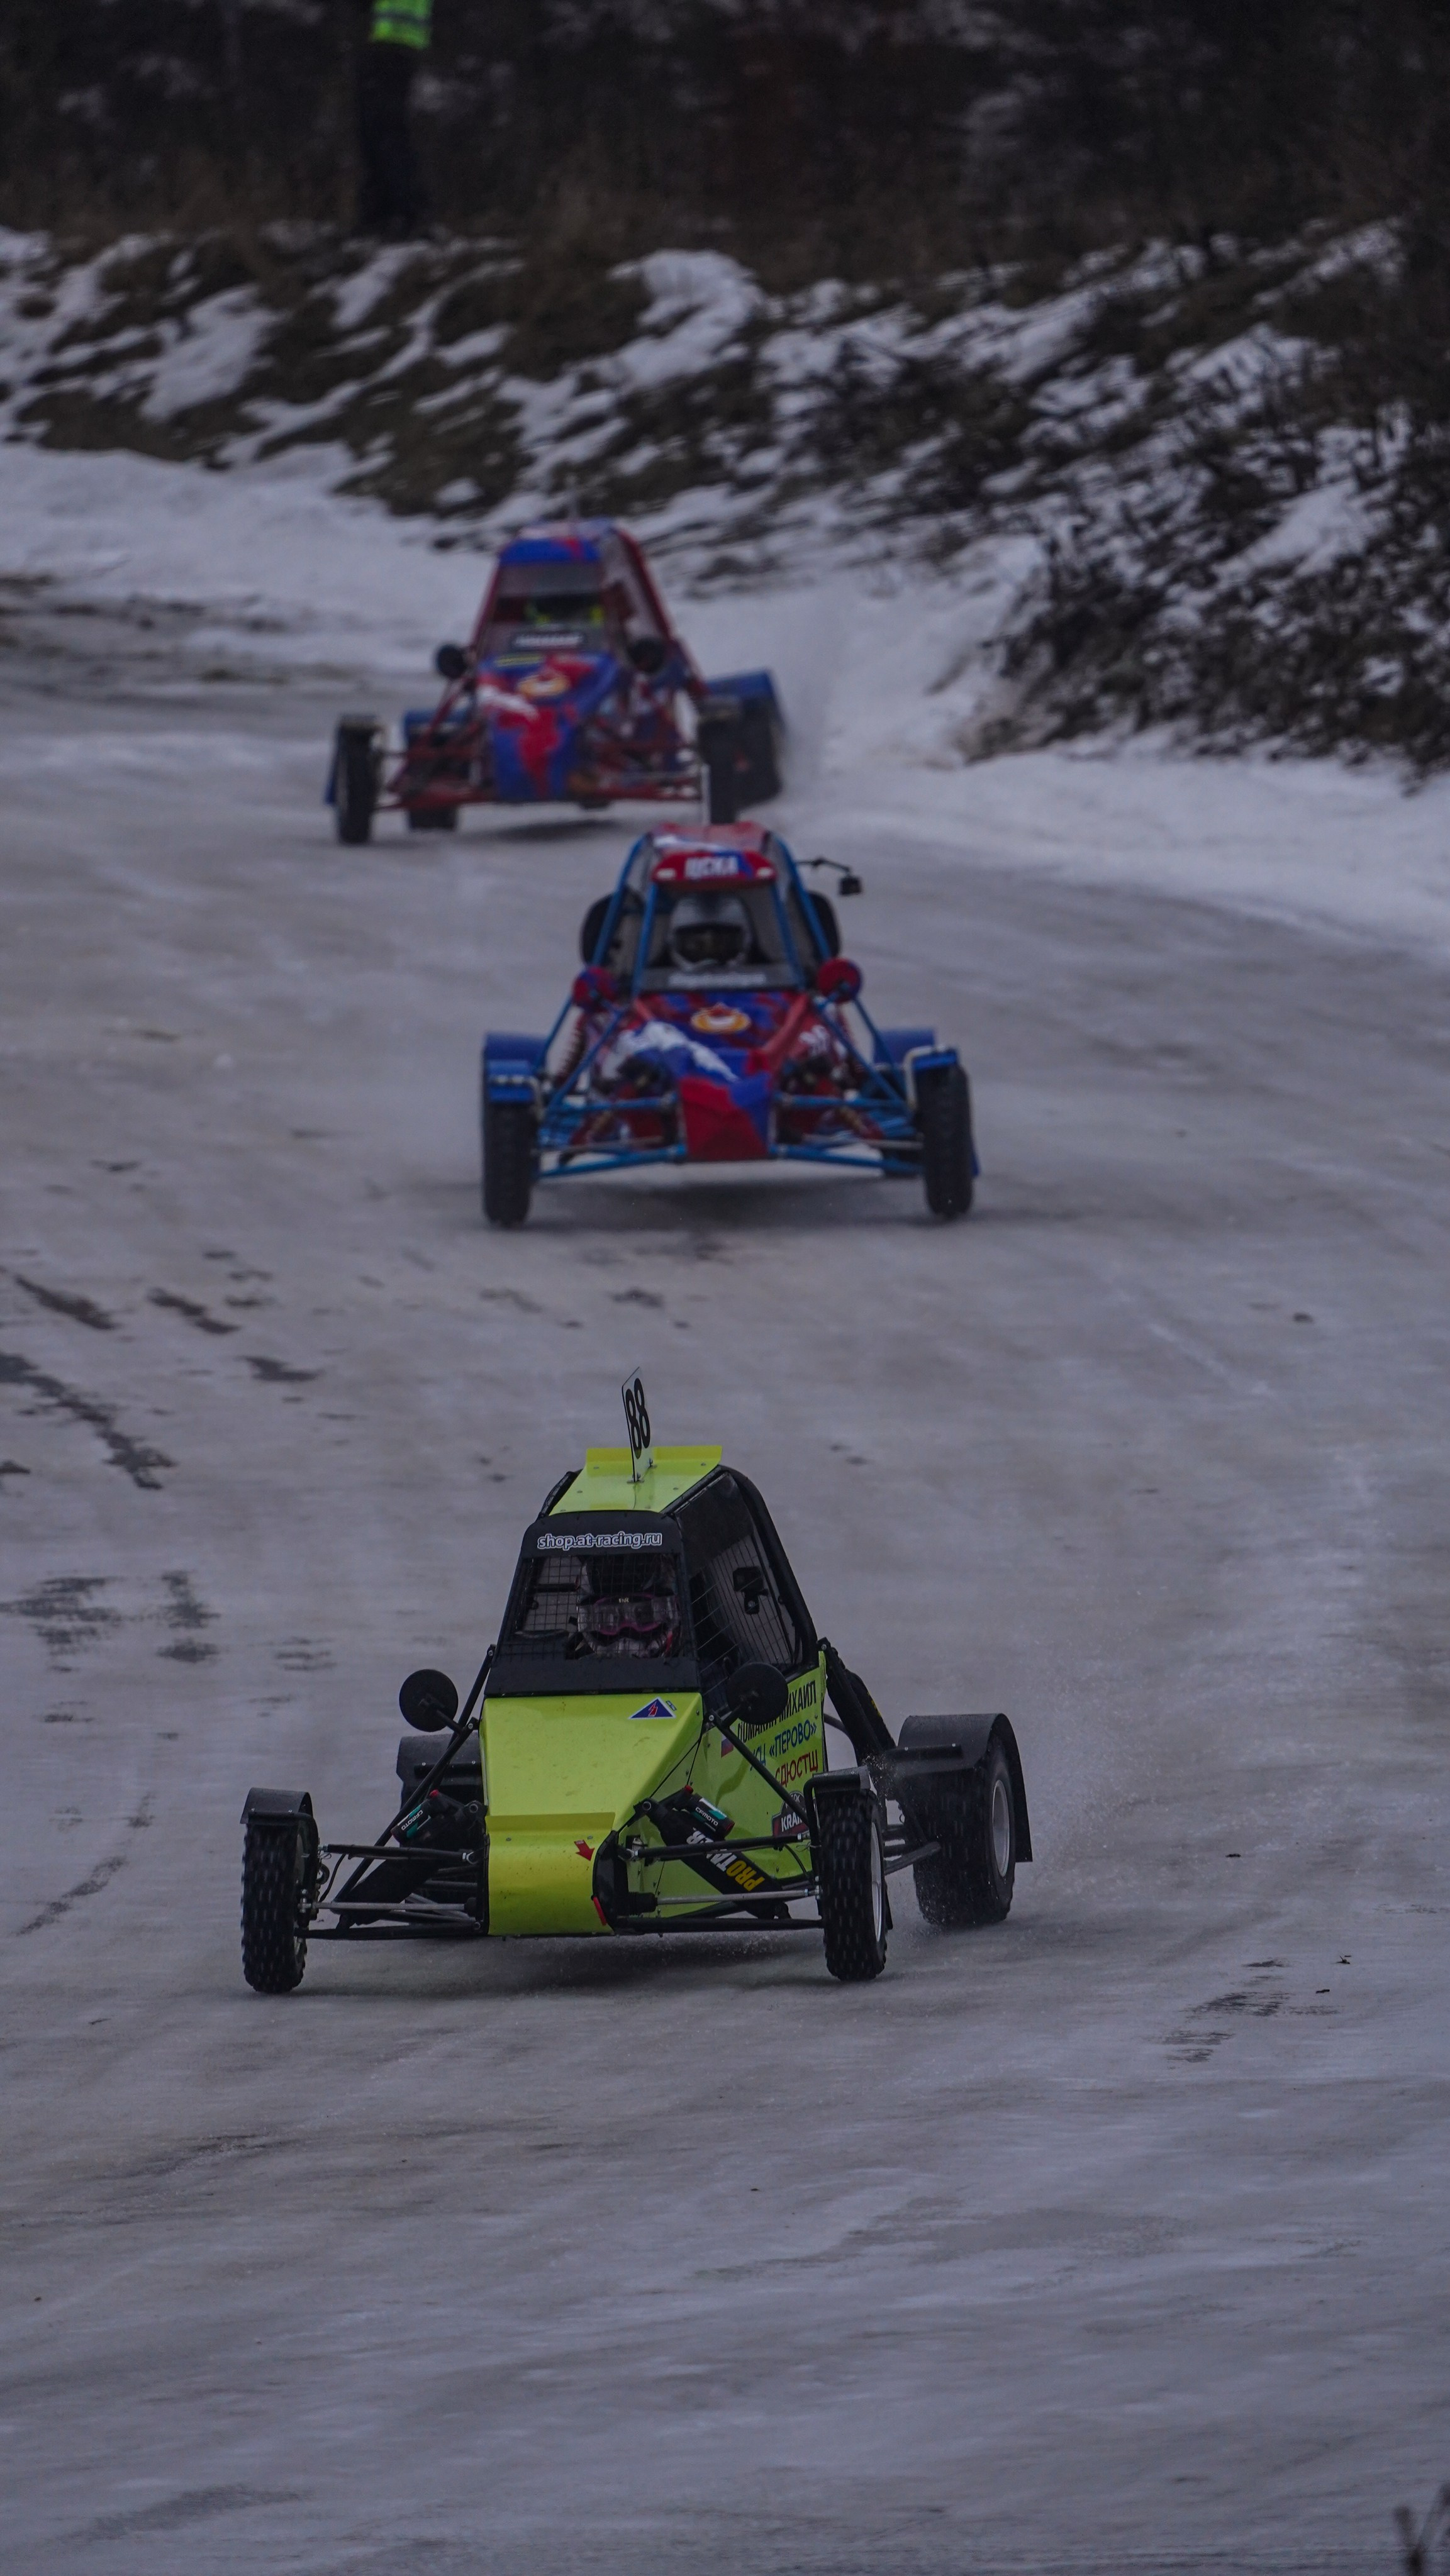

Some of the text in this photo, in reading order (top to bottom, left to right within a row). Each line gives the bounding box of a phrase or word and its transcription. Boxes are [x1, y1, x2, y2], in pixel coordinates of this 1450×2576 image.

[625, 1377, 651, 1460] 88
[537, 1531, 662, 1551] shop.at-racing.ru
[401, 1809, 423, 1831] CFMOTO
[694, 1806, 719, 1827] CFMOTO
